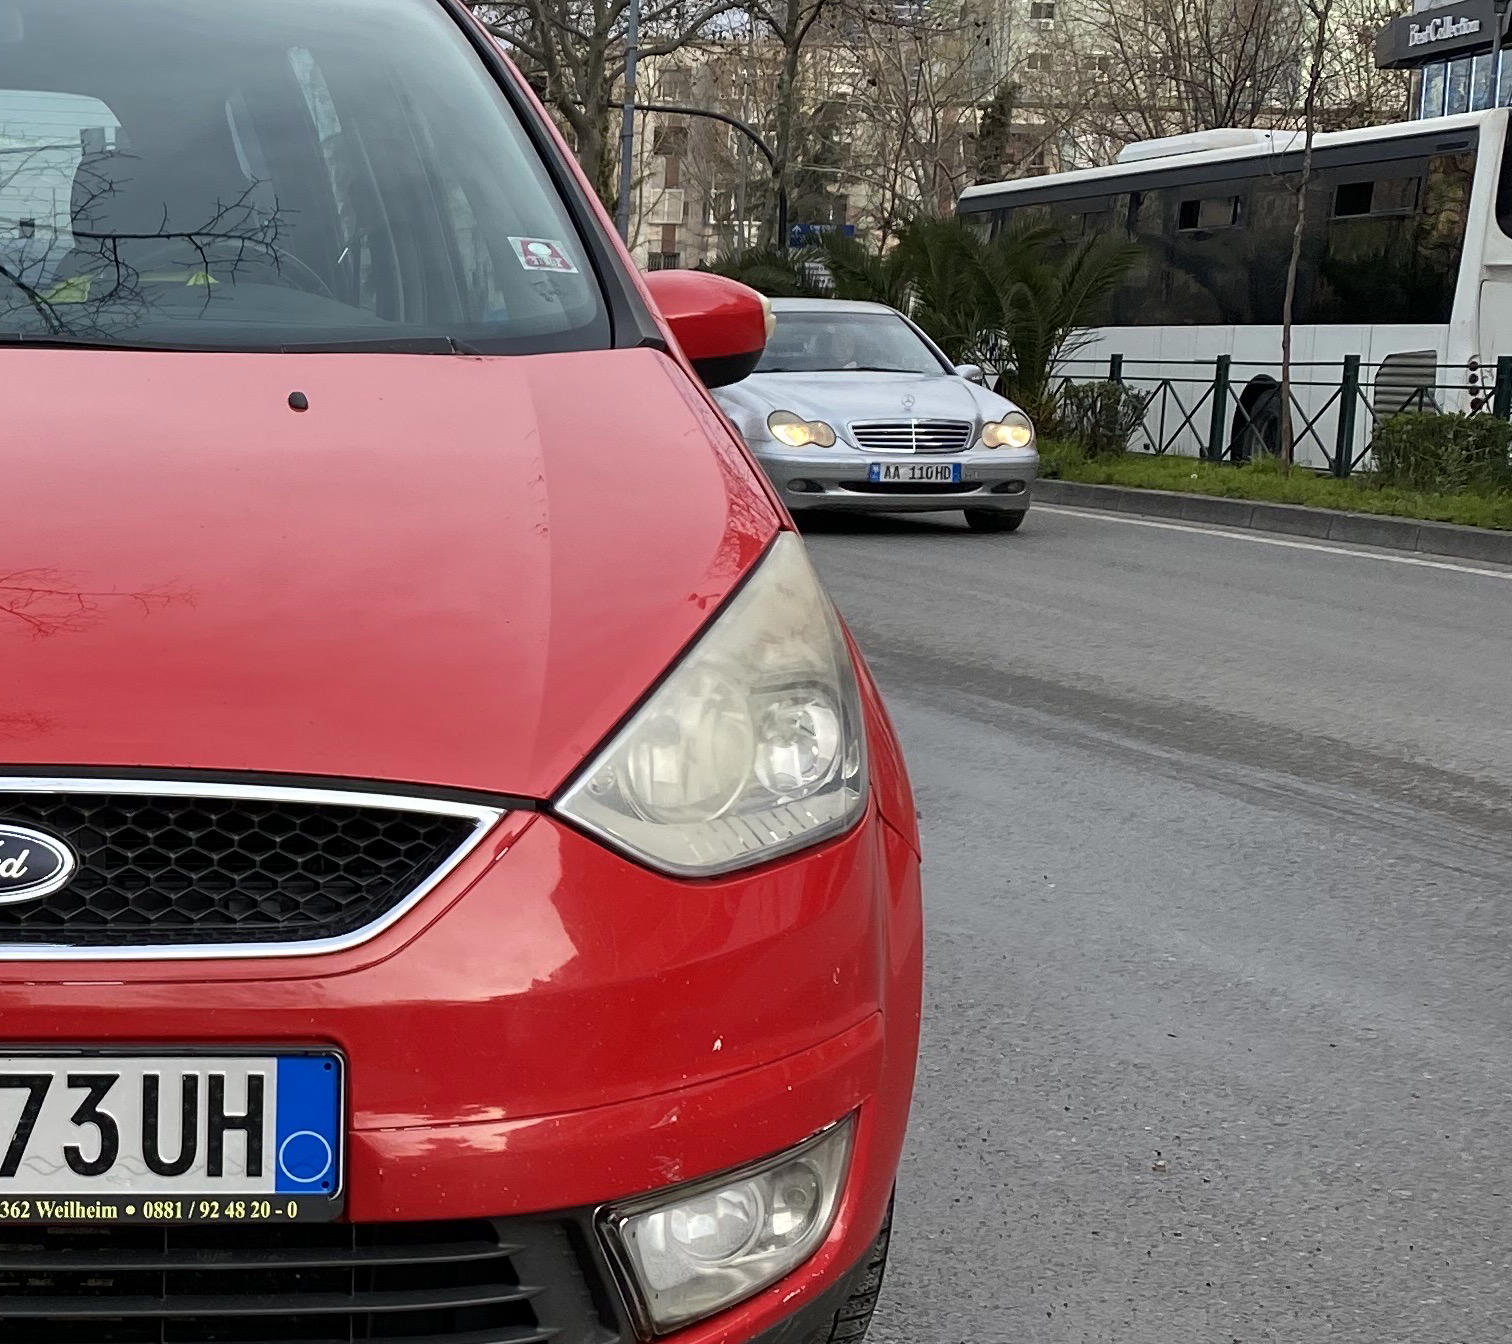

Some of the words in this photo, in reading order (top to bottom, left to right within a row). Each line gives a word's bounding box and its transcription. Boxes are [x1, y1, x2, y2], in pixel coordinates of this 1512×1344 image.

[883, 465, 900, 480] AA
[35, 1200, 118, 1219] Weilheim
[143, 1200, 183, 1220] 0881
[199, 1200, 220, 1219] 92
[224, 1200, 246, 1219] 48
[250, 1200, 271, 1219] 20
